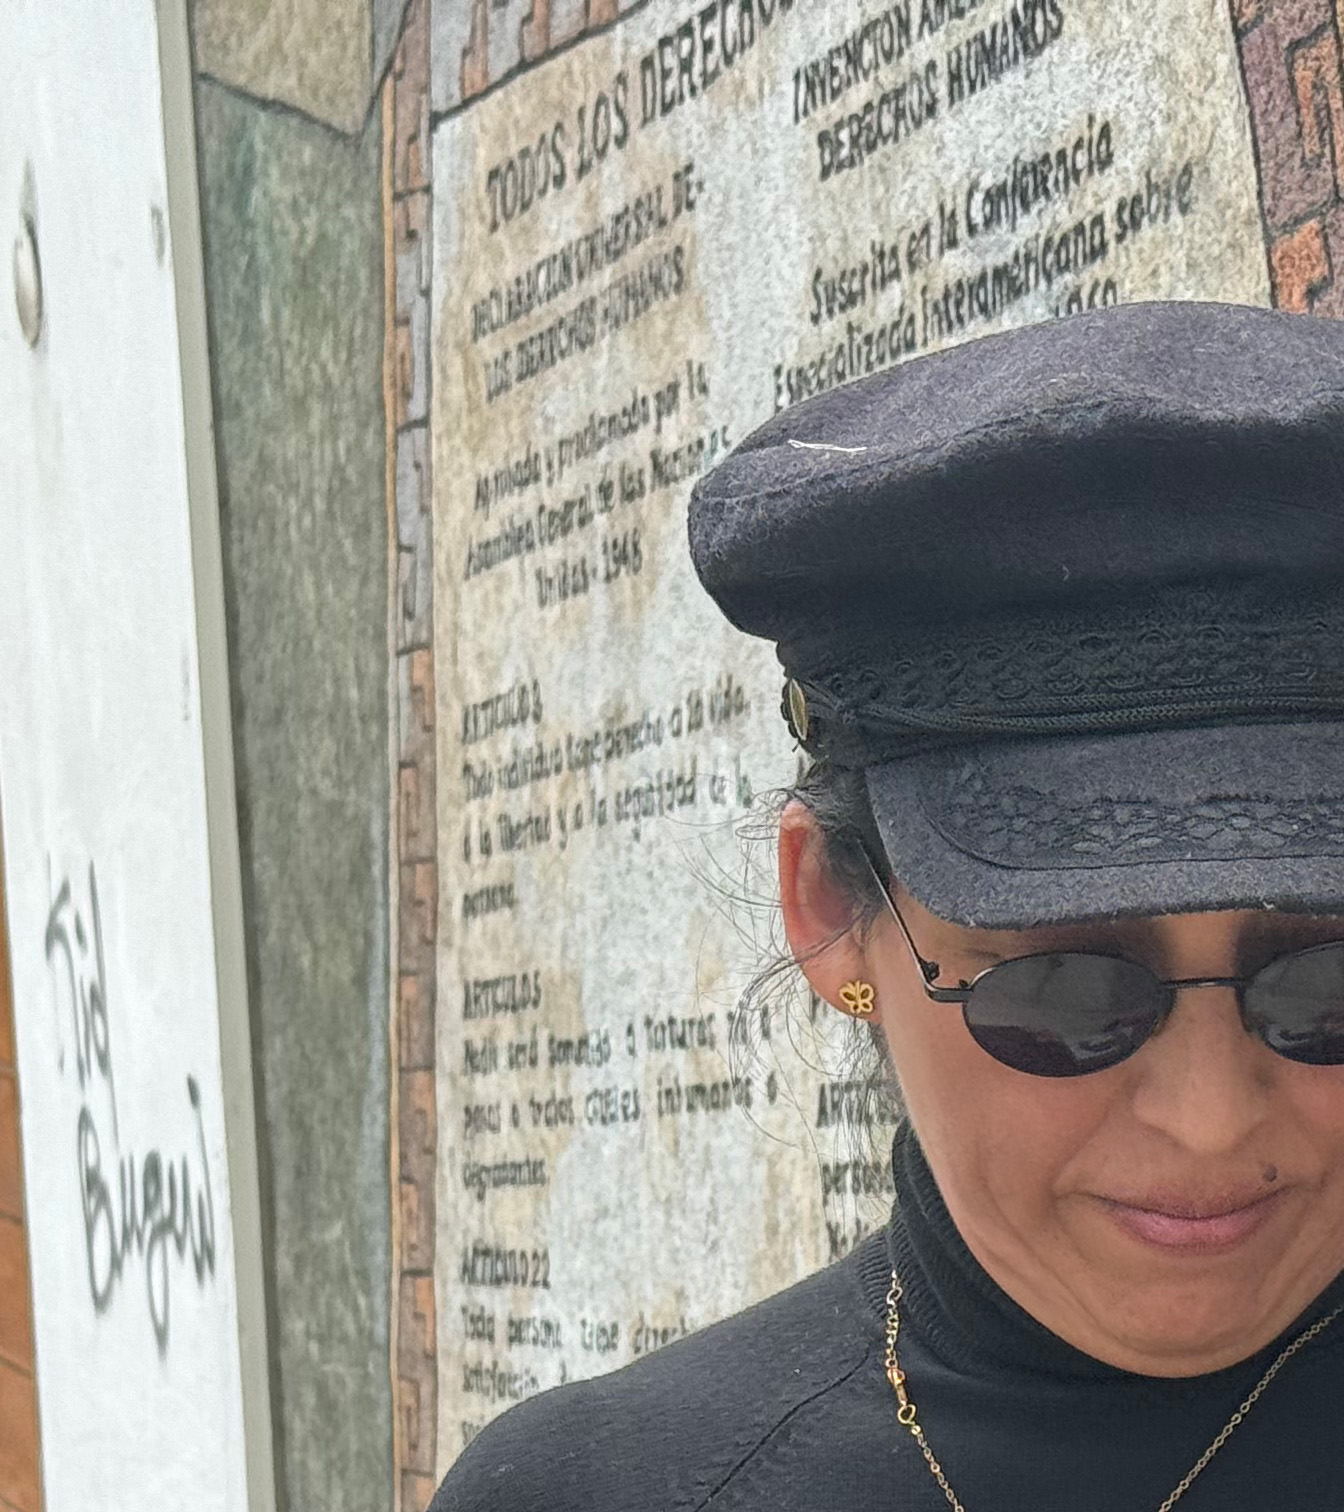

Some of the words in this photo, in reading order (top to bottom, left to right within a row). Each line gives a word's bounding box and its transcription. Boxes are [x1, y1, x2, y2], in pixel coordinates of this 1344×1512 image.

[487, 122, 565, 234] TODOS
[577, 71, 629, 182] LOS
[817, 59, 938, 182] DERECHOS
[947, 0, 1064, 108] HUMANOS
[1115, 161, 1194, 243] sobre
